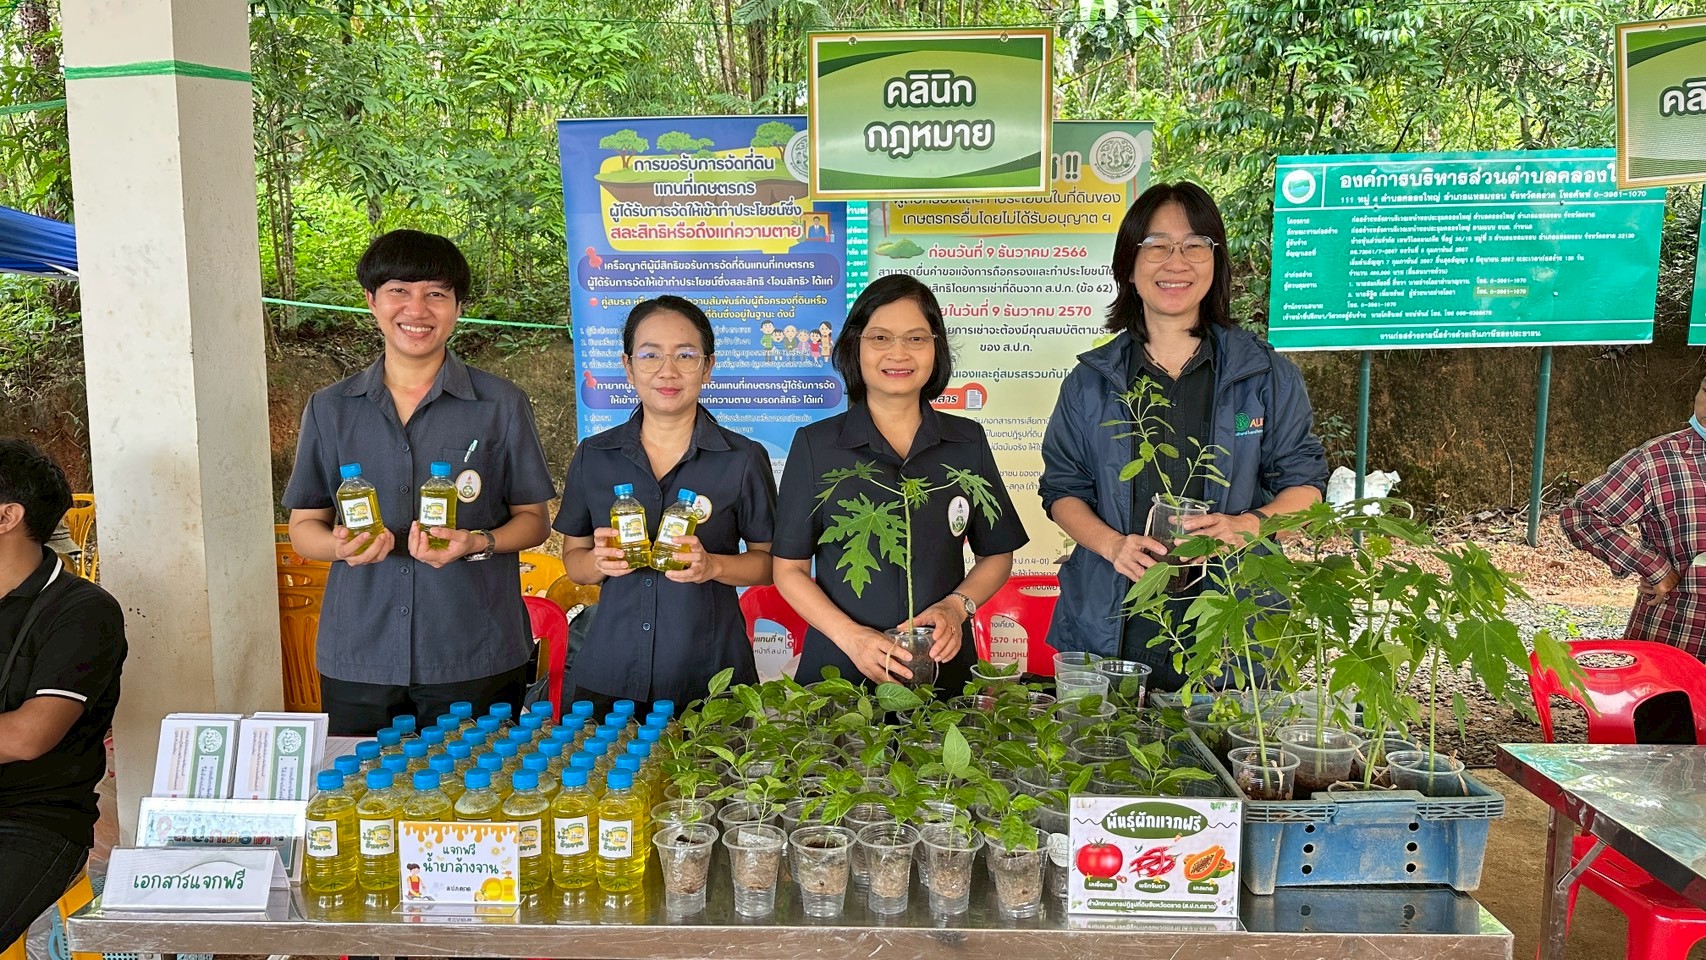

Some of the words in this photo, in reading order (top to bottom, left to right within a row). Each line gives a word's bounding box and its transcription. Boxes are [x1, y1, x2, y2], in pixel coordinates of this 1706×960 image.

[886, 72, 974, 106] คลินิก
[866, 121, 993, 157] กฎหมาย
[634, 148, 775, 172] การขอรับการจัดที่ดิน
[653, 174, 757, 195] แทนที่เกษตรกร
[1340, 196, 1354, 204] 111
[1356, 194, 1370, 206] หมู่
[1372, 196, 1379, 204] 4
[1380, 192, 1442, 204] ตำบลคลองใหญ่
[1443, 190, 1507, 202] อำเภอแหลมงอบ
[1509, 189, 1556, 201] จังหวัดตราด
[1558, 188, 1591, 199] โทรศัพท์
[1593, 189, 1648, 199] 0-3961-1070
[609, 196, 803, 223] ผู้ได้รับการจัดให้เข้าทำประโยชน์ซึ่ง
[903, 210, 1098, 228] เกษตรกรอื่นโดยไม่ได้รับอนุญาต
[610, 220, 802, 241] สละสิทธิหรือถึงแก่ความตาย
[928, 239, 984, 260] ก่อนวันที่
[985, 246, 995, 260] 9
[997, 244, 1050, 260] ธันวาคม
[1052, 246, 1088, 259] 2566
[603, 256, 815, 274] เครือญาติผู้มีสิทธิขอรับการจัดที่ดินแทนที่เกษตรกร
[587, 273, 765, 291] ผู้ได้รับการจัดให้เข้าทำประโยชน์ซึ่งสละสิทธิ
[766, 275, 810, 287] <โอนสิทธิ>
[812, 274, 834, 287] ได้แก่
[1045, 283, 1075, 296] ส.ป.ก.
[1076, 281, 1095, 297] (ข้อ
[1096, 282, 1113, 297] 62)
[991, 305, 1001, 319] 9
[1003, 303, 1055, 319] ธันวาคม
[1058, 305, 1092, 317] 2570
[979, 343, 1001, 353] ของ
[1002, 342, 1033, 353] ส.ป.ก.
[803, 395, 824, 405] ได้แก่
[1106, 810, 1202, 834] พันธุ์ผักแจกฟรี
[442, 843, 476, 856] แจกฟรี
[422, 852, 500, 876] น้ำยาล้างจาน
[133, 868, 247, 891] เอกสารแจกฟรี
